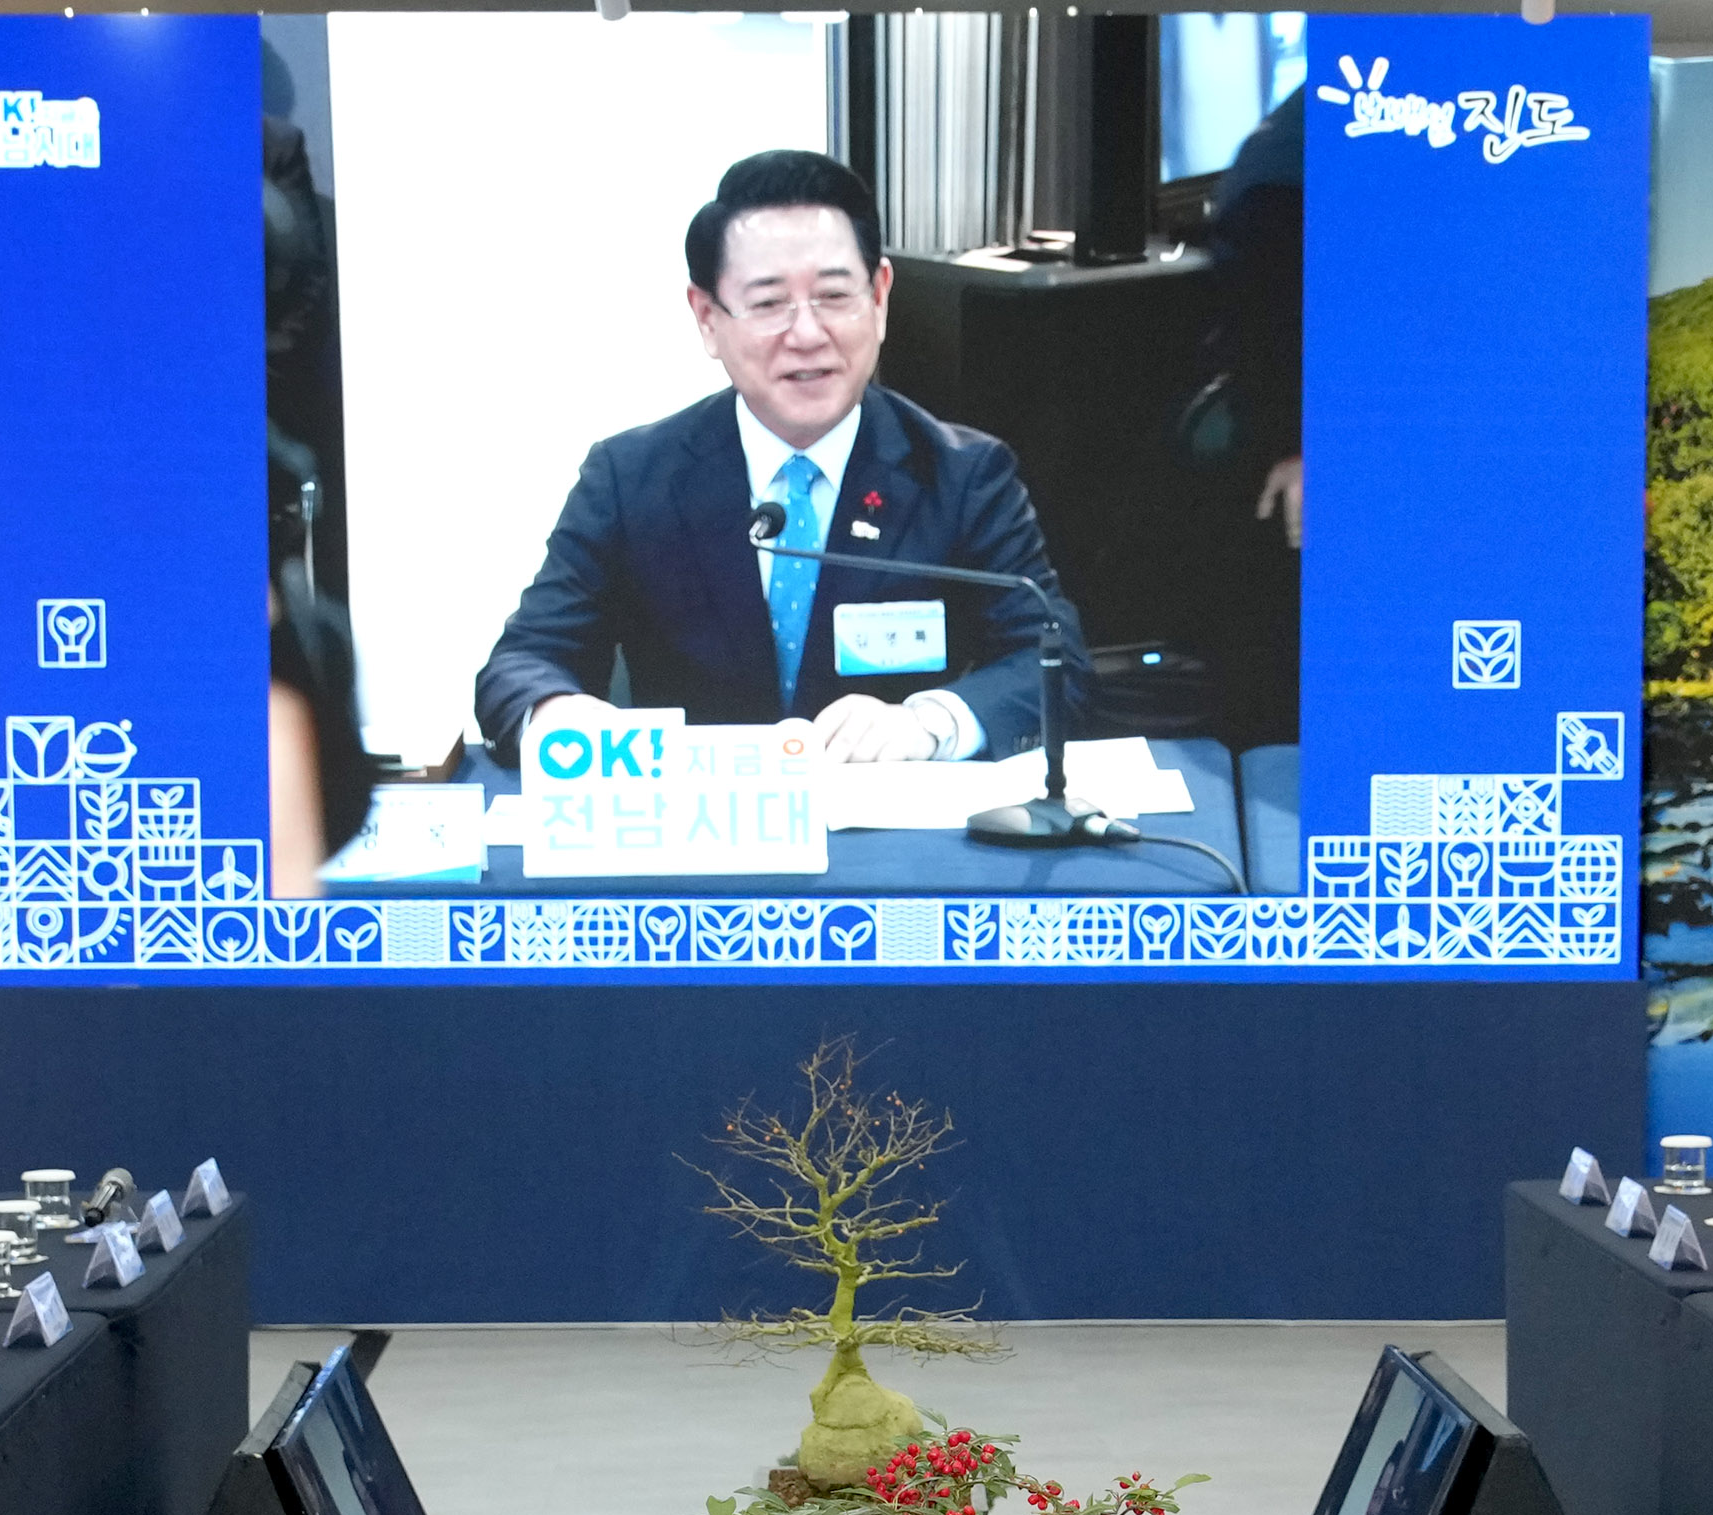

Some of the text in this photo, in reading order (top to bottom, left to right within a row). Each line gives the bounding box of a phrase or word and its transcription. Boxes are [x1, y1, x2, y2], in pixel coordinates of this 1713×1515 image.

[1458, 84, 1590, 164] 진도
[539, 728, 810, 780] OK! 지금은
[543, 791, 811, 850] 전남시대
